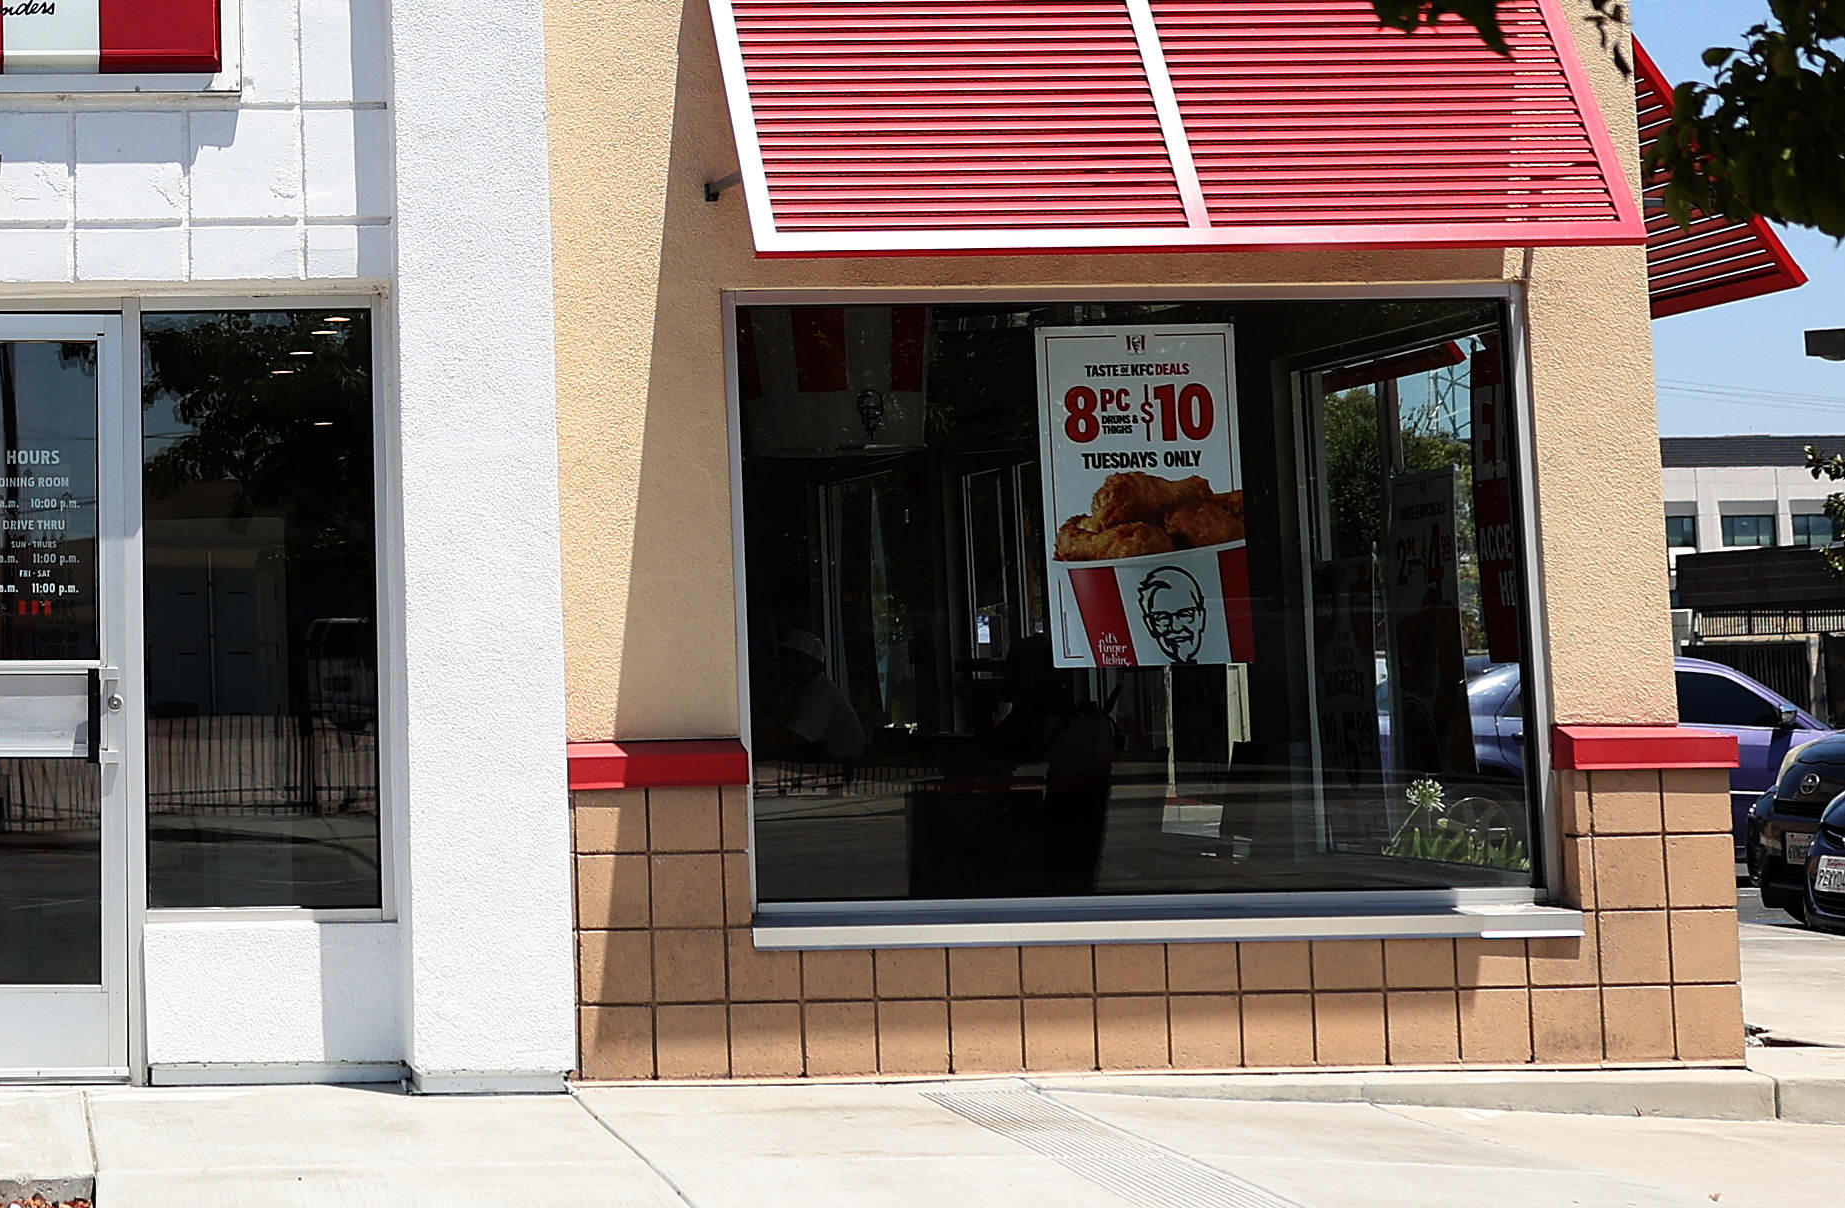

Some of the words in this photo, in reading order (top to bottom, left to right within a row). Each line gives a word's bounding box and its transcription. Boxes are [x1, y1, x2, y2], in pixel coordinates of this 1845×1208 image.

[1085, 365, 1118, 377] TASTE
[1131, 364, 1154, 376] KFC
[1155, 363, 1190, 375] DEALS
[1064, 386, 1100, 443] 8
[1100, 388, 1131, 412] PC
[1141, 383, 1215, 442] $10
[1101, 415, 1131, 424] DRUMS
[1102, 425, 1133, 434] THIGHS
[6, 450, 60, 465] HOURS
[1082, 451, 1157, 470] TUESDAYS
[1163, 450, 1202, 468] ONLY
[38, 477, 69, 488] ROOM
[30, 498, 57, 509] 10:00
[60, 499, 80, 511] p.m.
[3, 520, 35, 530] DRIVE
[37, 520, 65, 530] THRU
[33, 553, 57, 564] 11:00
[60, 555, 80, 566] p.m.
[19, 570, 31, 578] FRI
[37, 570, 51, 578] SAT
[32, 582, 56, 593] 11:00
[58, 584, 79, 596] p.m.
[1097, 639, 1127, 656] finger
